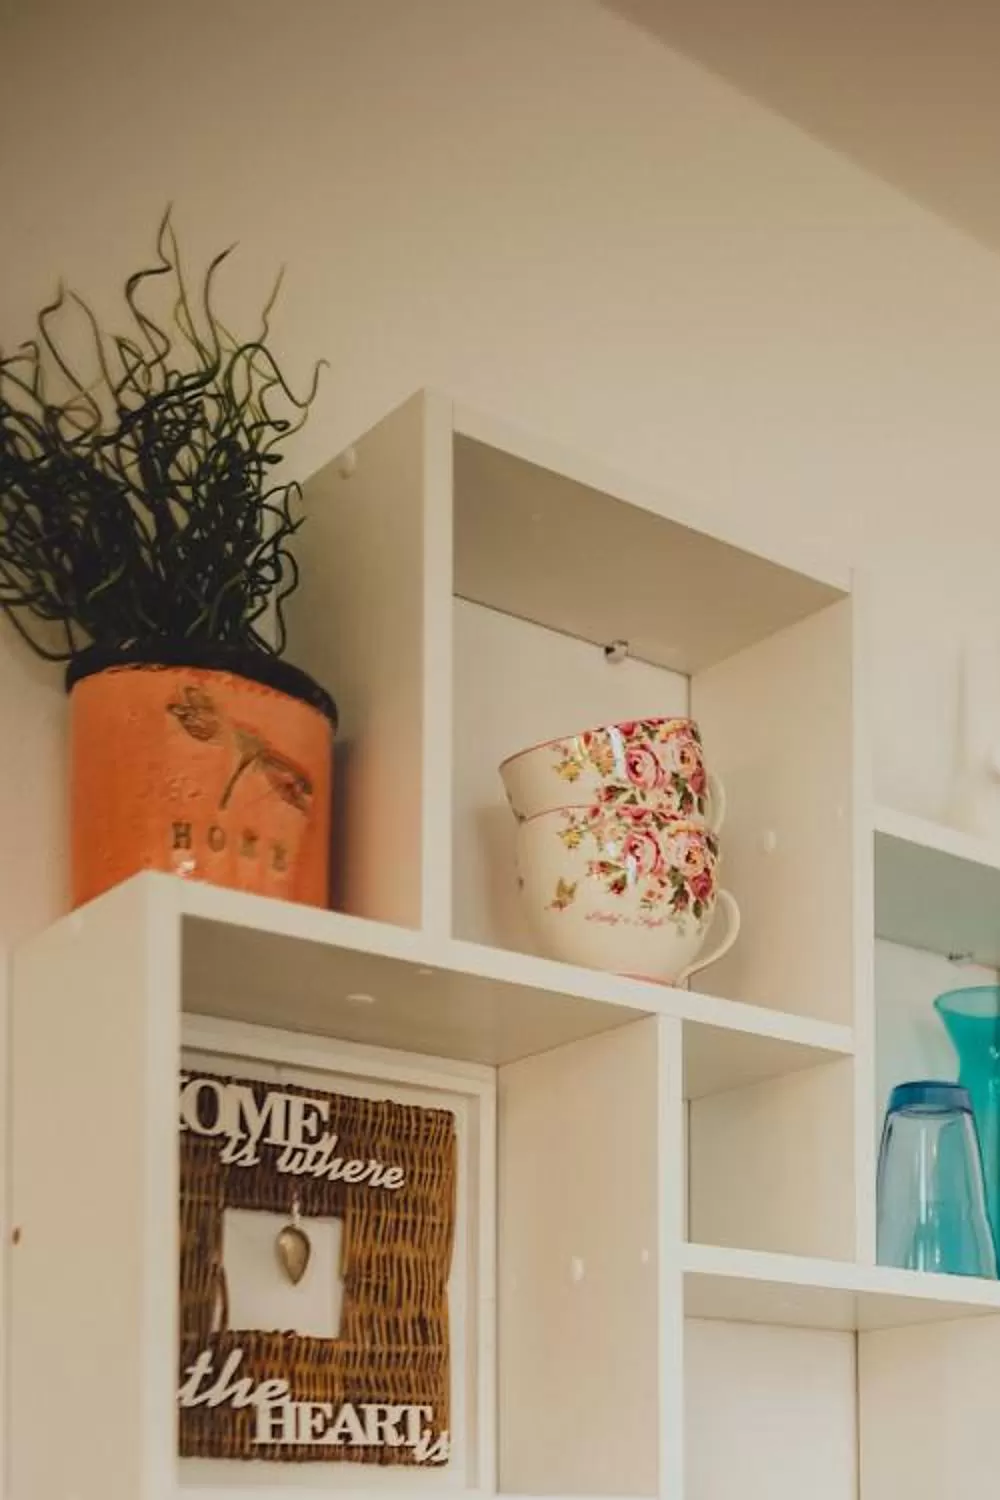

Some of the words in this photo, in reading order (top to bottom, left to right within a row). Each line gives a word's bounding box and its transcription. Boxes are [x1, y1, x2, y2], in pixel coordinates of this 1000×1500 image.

[180, 1077, 329, 1149] OME
[276, 1131, 405, 1190] where
[177, 1348, 291, 1408] the
[253, 1400, 433, 1447] HEART
